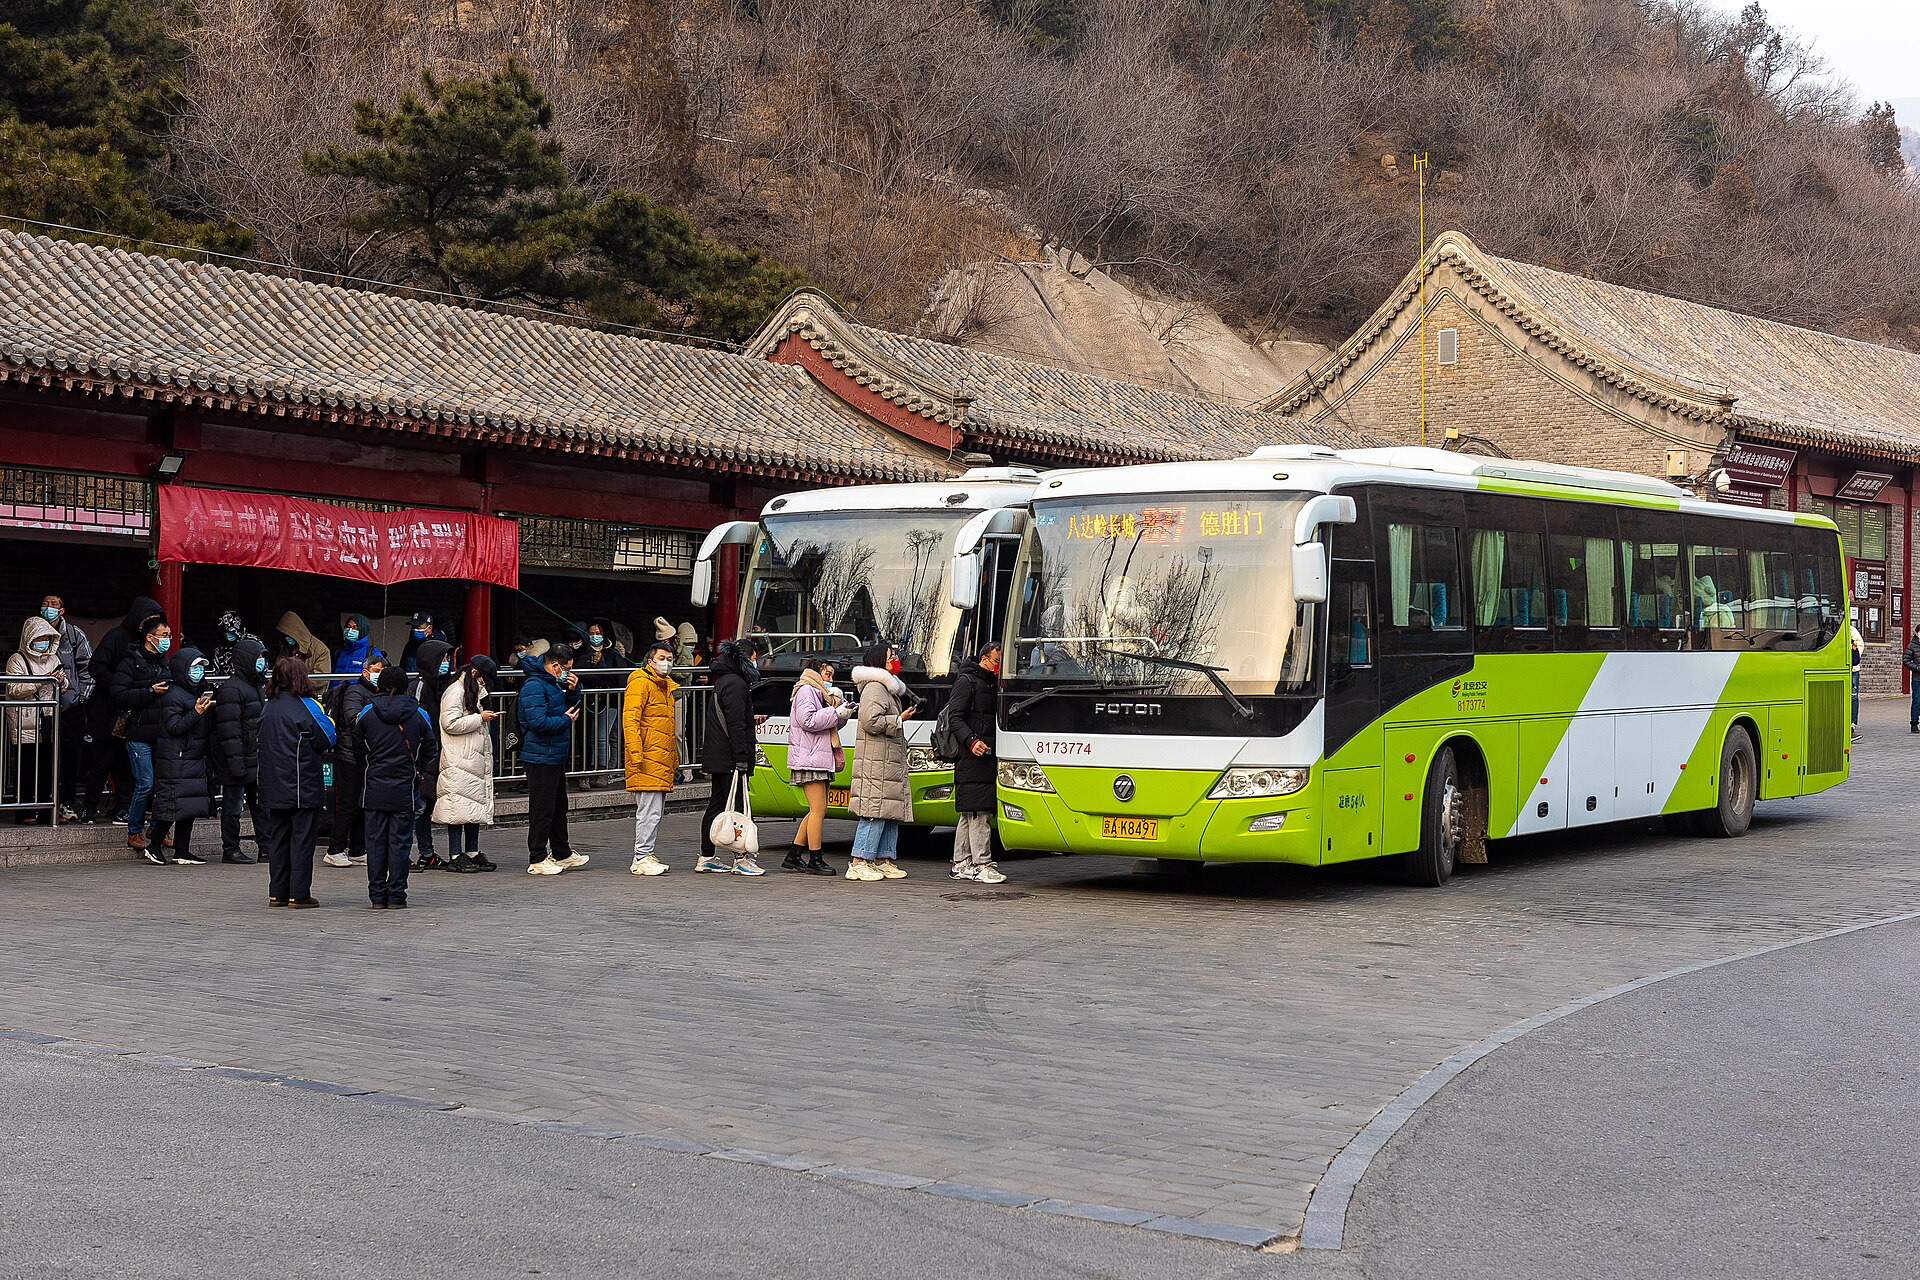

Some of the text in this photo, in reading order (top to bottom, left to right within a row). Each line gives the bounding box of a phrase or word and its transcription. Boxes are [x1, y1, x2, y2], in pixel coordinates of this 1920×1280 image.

[1066, 512, 1137, 540] 八达岭长城
[1199, 510, 1263, 537] 德胜门
[289, 511, 379, 570] 科学应对
[1462, 681, 1488, 691] 北京公交
[1094, 703, 1162, 715] FOTON
[1457, 699, 1486, 711] 8173774
[1036, 741, 1092, 755] 8173774
